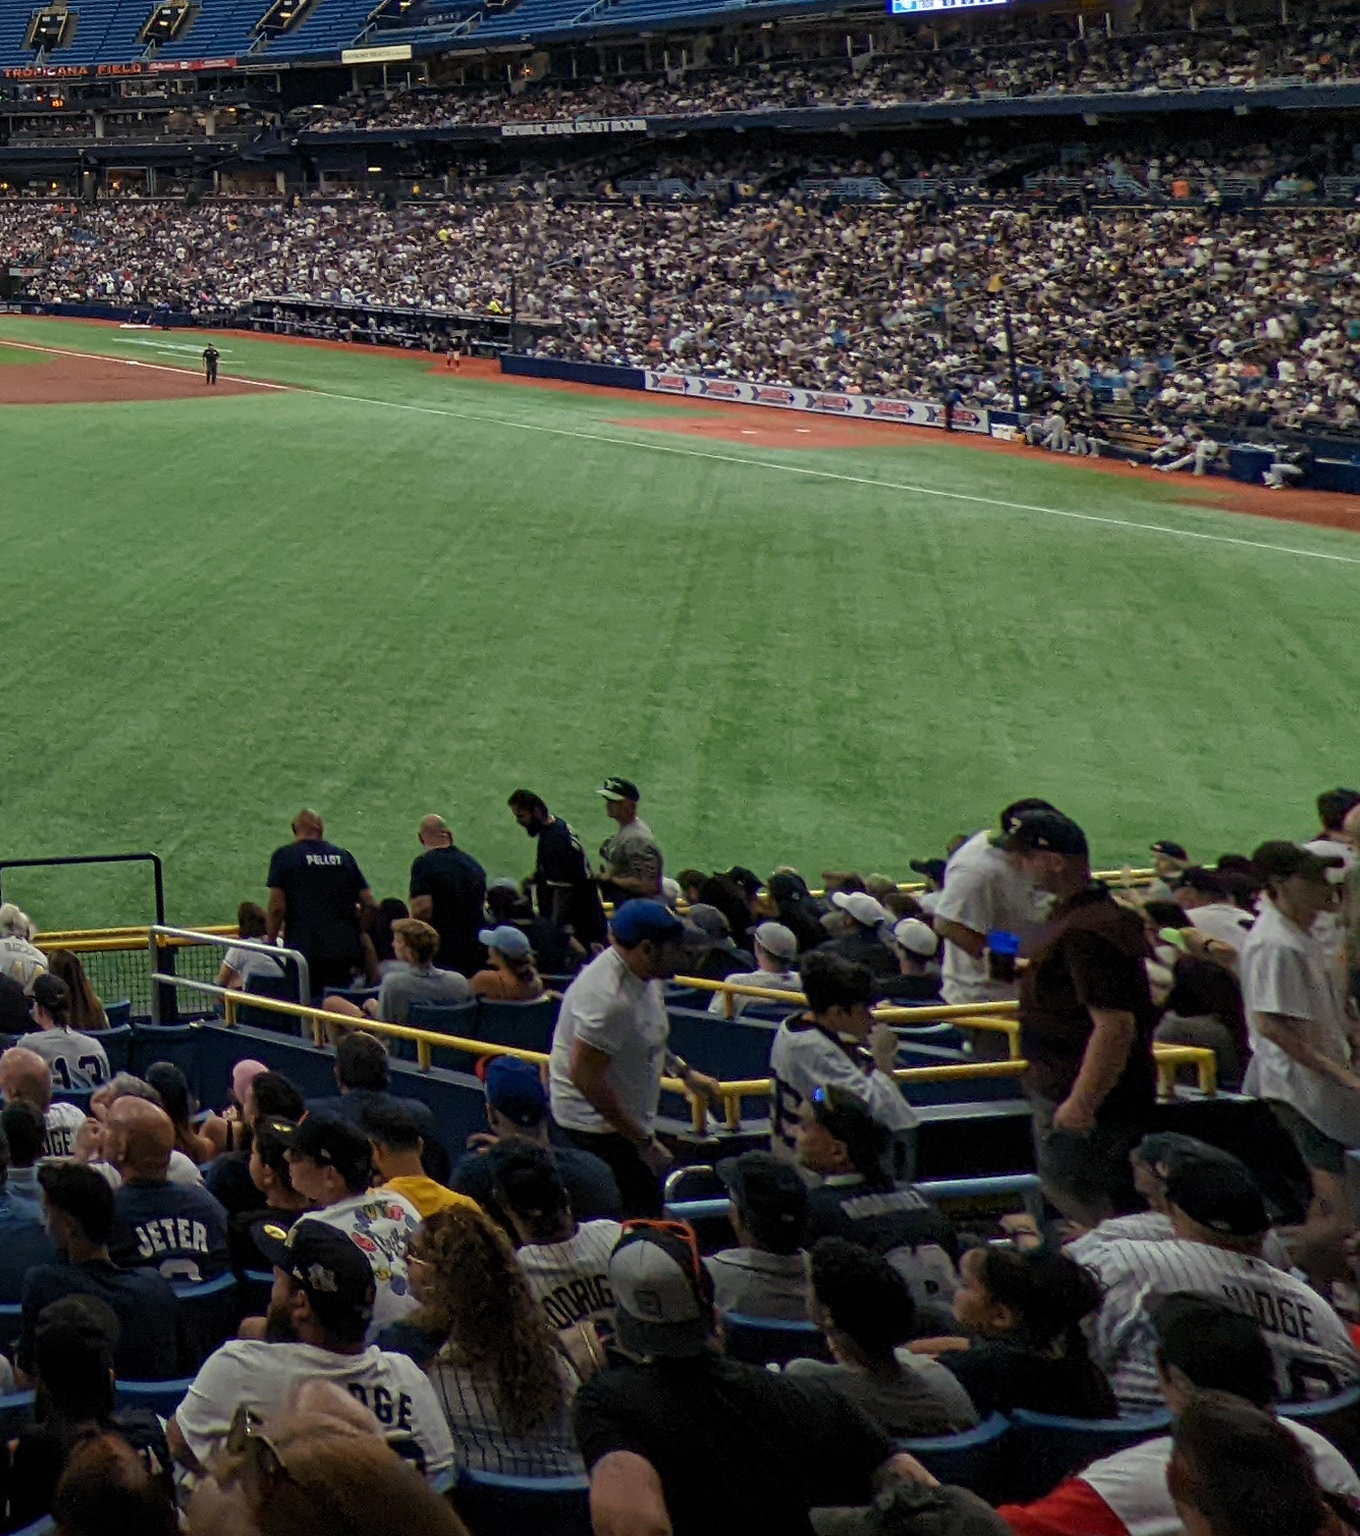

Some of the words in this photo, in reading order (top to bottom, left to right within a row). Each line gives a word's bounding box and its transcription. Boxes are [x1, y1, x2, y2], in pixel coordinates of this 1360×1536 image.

[3, 66, 90, 79] TROPICANA
[96, 63, 142, 76] FIELD
[134, 1217, 210, 1259] JETER
